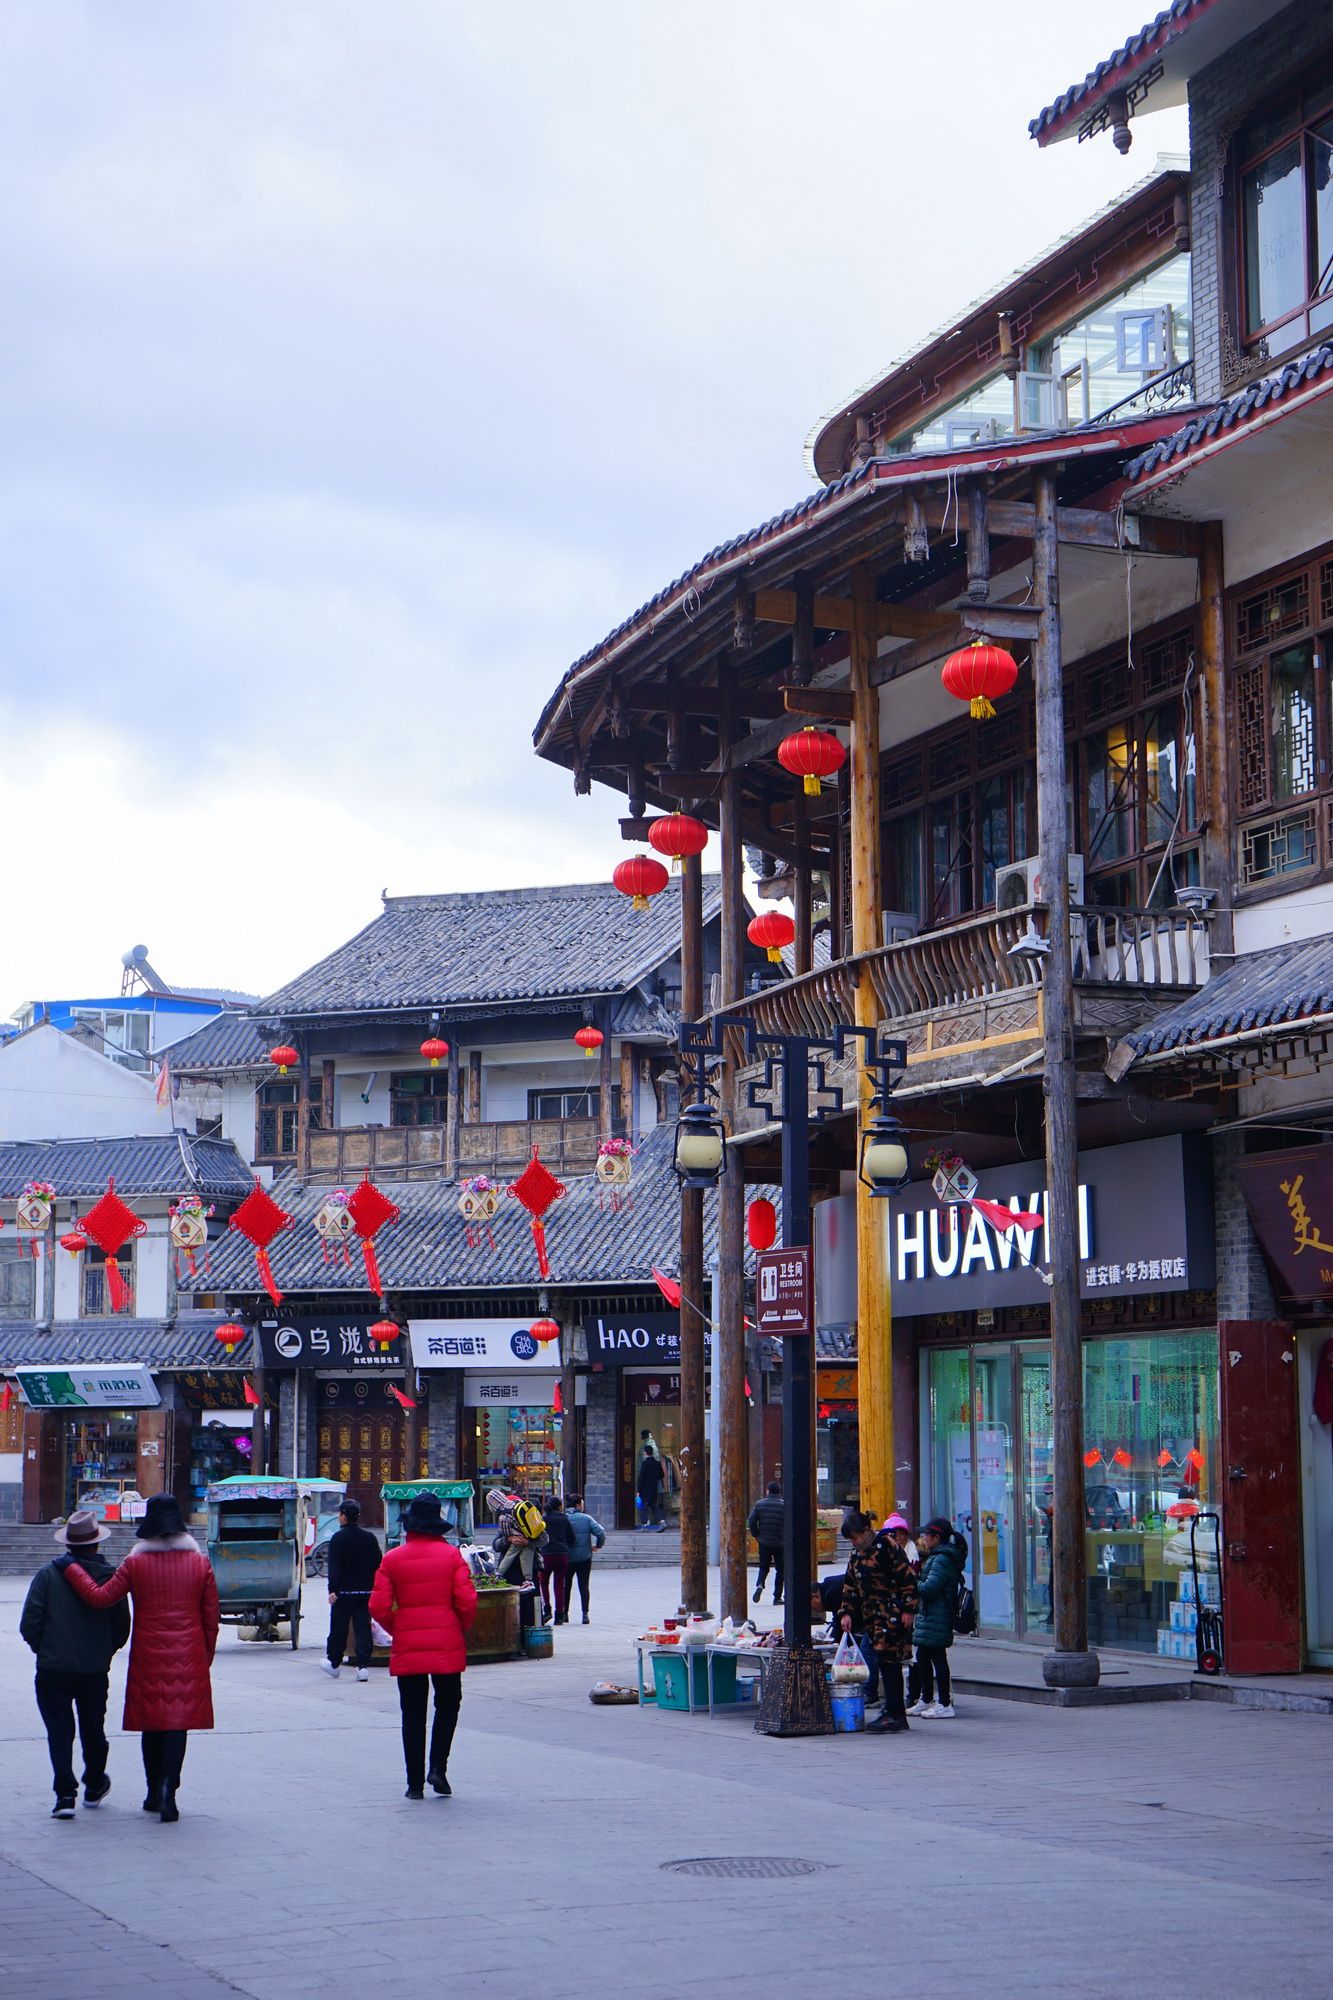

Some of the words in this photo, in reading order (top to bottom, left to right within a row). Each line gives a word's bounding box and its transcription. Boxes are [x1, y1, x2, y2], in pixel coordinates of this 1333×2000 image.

[897, 1184, 1092, 1281] HUAWI
[780, 1261, 803, 1277] 卫生间
[780, 1279, 803, 1288] RESTROOM
[310, 1326, 374, 1356] 乌泷
[427, 1337, 475, 1355] 茶百道
[514, 1335, 531, 1344] CHA
[516, 1346, 534, 1354] DAO
[480, 1385, 511, 1398] 茶百道
